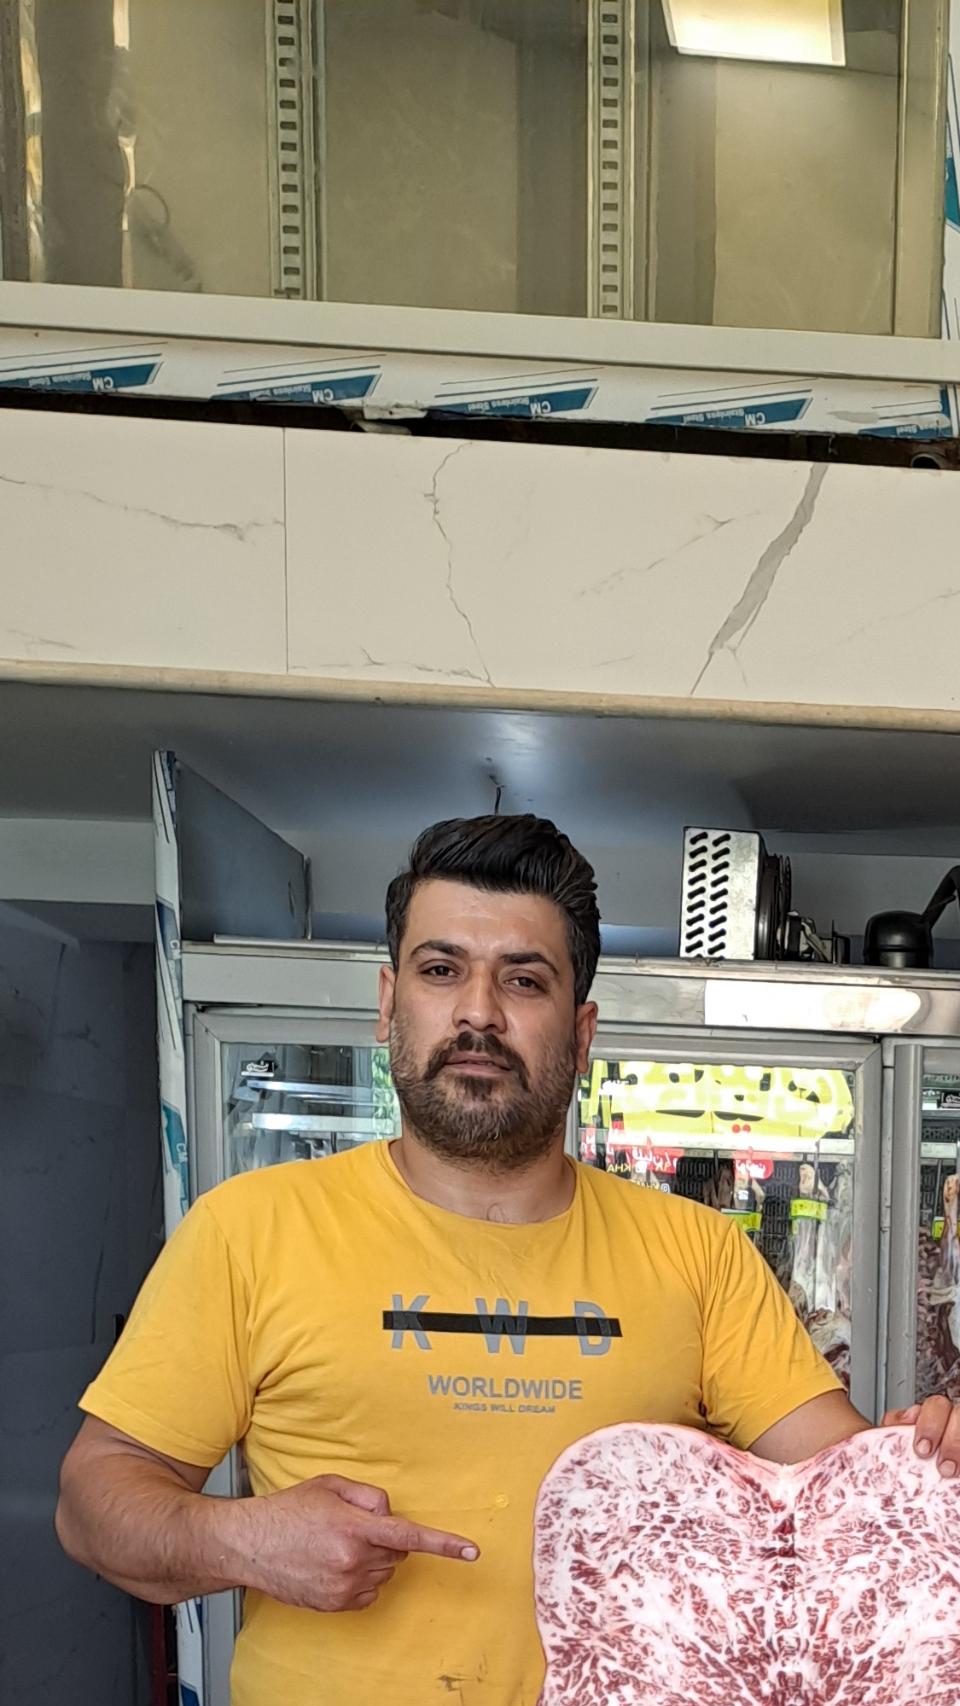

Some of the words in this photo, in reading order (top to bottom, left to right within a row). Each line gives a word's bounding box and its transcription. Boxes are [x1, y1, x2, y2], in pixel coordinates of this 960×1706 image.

[92, 376, 114, 391] CM
[312, 388, 334, 404] CM
[530, 400, 551, 416] CM
[745, 412, 766, 426] CM
[427, 1374, 584, 1401] WORLDWIDE
[453, 1402, 487, 1412] KINGS
[490, 1403, 515, 1413] WILL
[518, 1404, 556, 1413] DREAM
